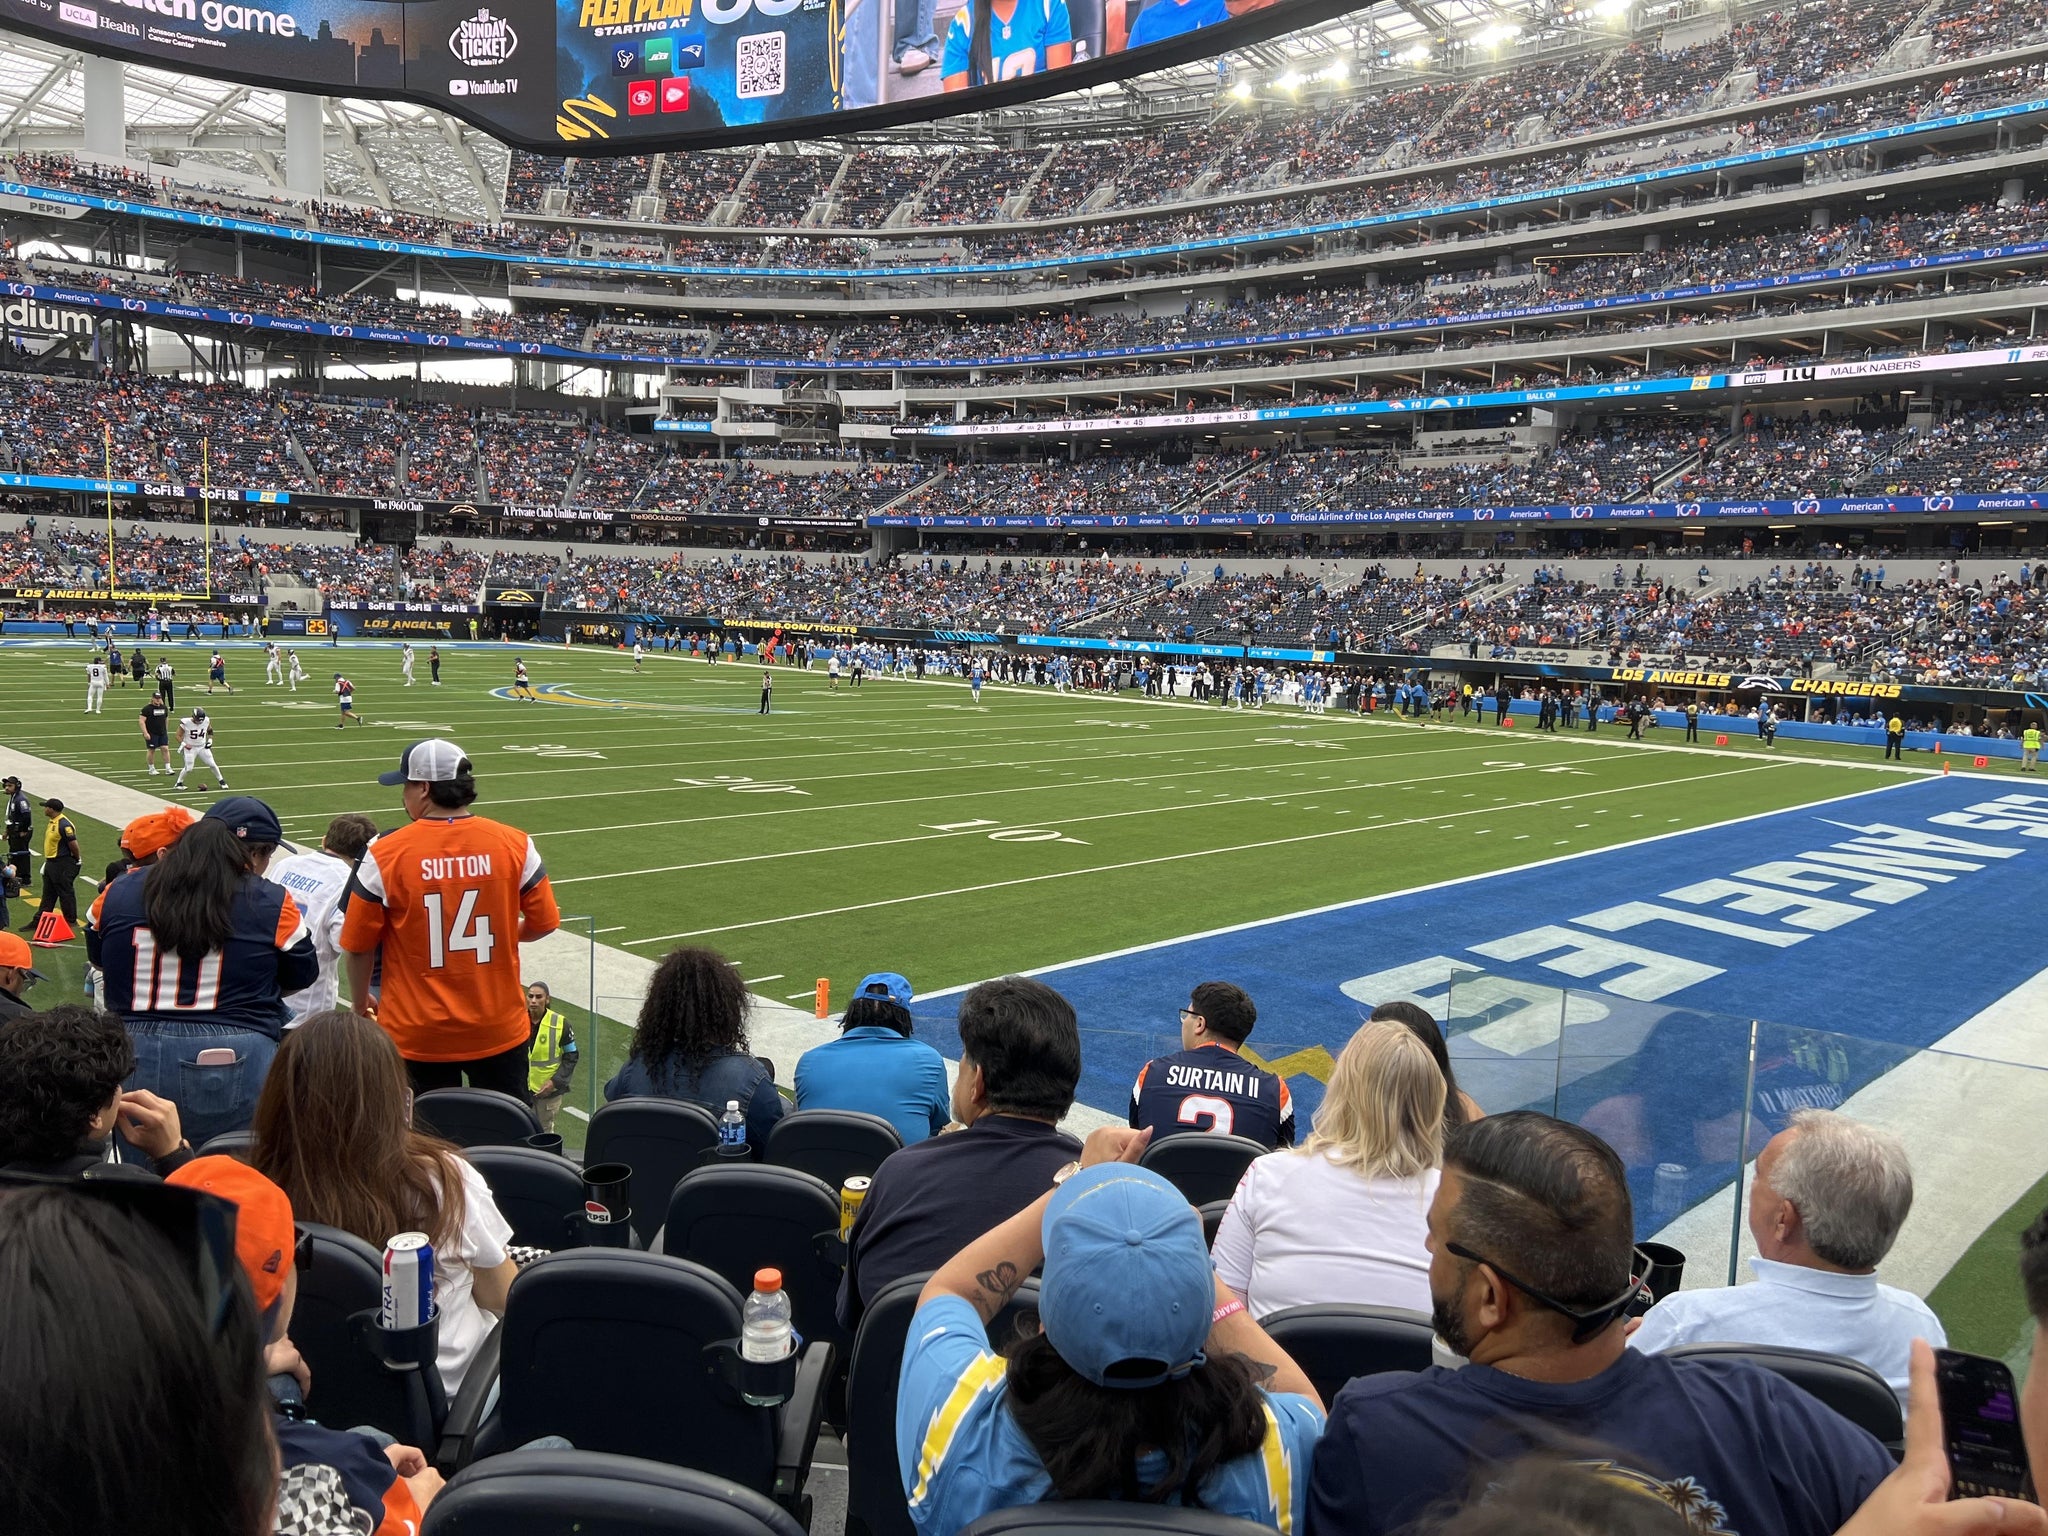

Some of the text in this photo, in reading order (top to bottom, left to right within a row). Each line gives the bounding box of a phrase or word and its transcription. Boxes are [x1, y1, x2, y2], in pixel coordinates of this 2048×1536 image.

[40, 1, 52, 11] by
[579, 0, 632, 28] FLEX
[633, 0, 693, 20] PLAN
[803, 2, 826, 11] GAME
[65, 8, 140, 36] UCLA Health
[201, 1, 296, 37] game
[460, 18, 508, 40] SUNDAY
[594, 18, 690, 37] STARTING AT
[148, 27, 227, 48] Jonsson Comprehensive
[148, 33, 195, 49] Cancer Center
[460, 37, 508, 60] TICKET
[469, 78, 518, 95] YouTube TV
[1498, 176, 1636, 205] Official Airline of the Los Angeles Chargers
[29, 201, 67, 216] PEPSI
[42, 191, 78, 203] American
[140, 208, 174, 219] American
[234, 222, 267, 234] American
[324, 236, 355, 247] American
[410, 246, 440, 256] American
[54, 291, 91, 303] American
[165, 306, 200, 318] American
[270, 319, 302, 331] American
[369, 330, 400, 341] American
[464, 340, 494, 350] American
[1446, 314, 1470, 324] Official
[1471, 311, 1492, 321] Airline
[1493, 310, 1500, 318] of
[1501, 309, 1512, 318] the
[1513, 307, 1525, 317] Los
[1526, 305, 1553, 317] Angeles
[1554, 302, 1584, 314] Chargers
[892, 427, 917, 435] AROUND
[918, 427, 930, 435] THE
[1085, 421, 1094, 429] 17
[1184, 416, 1195, 424] 23
[1238, 412, 1249, 420] 13
[1411, 401, 1421, 409] 10
[1526, 392, 1545, 401] BALL
[1545, 391, 1557, 399] ON
[1694, 379, 1708, 388] 25
[1745, 373, 1766, 384] WR1
[1830, 363, 1867, 377] MALIK
[1868, 360, 1922, 374] NABERS
[2007, 350, 2021, 362] 11
[115, 483, 226, 499] ON SoFi SoFi
[373, 500, 387, 510] The
[388, 500, 407, 511] 1960
[407, 500, 424, 512] Club
[503, 506, 509, 516] A
[510, 506, 535, 518] Private
[536, 506, 553, 518] Club
[554, 508, 578, 520] Unlike
[593, 509, 614, 521] Other
[630, 513, 687, 522] the1960club.com
[1139, 517, 1163, 525] American
[1211, 516, 1236, 524] American
[1291, 512, 1317, 522] Official
[1319, 512, 1344, 521] Airline
[1345, 511, 1354, 521] of
[1355, 511, 1368, 520] the
[1370, 511, 1383, 520] Los
[1384, 510, 1416, 522] Angeles
[1418, 510, 1454, 521] Chargers
[1509, 509, 1542, 519] American
[1610, 507, 1645, 517] American
[1720, 505, 1758, 515] American
[1841, 501, 1884, 512] American
[1978, 498, 2025, 509] American
[16, 589, 42, 598] LOS
[46, 589, 109, 600] ANGELES
[229, 595, 249, 603] SoFi
[330, 601, 459, 613] SoFi SoFi SoFi SoFi
[308, 620, 326, 633] 25
[364, 619, 390, 629] LOS
[723, 619, 858, 634] CHARGERS.COM/TICKETS
[93, 668, 100, 677] 8
[1612, 668, 1903, 698] LOS ANGELES CHARGERS
[190, 729, 205, 740] 54
[1978, 757, 1986, 766] G
[919, 818, 1063, 842] 10
[421, 854, 492, 881] SUTTON
[280, 871, 323, 894] HERBERT
[36, 916, 54, 938] 10
[423, 889, 495, 970] 14
[1339, 816, 2027, 1057] ANGELES
[131, 926, 224, 1012] 10
[1166, 1064, 1260, 1099] SURTAIN II
[843, 1202, 859, 1215] Pu
